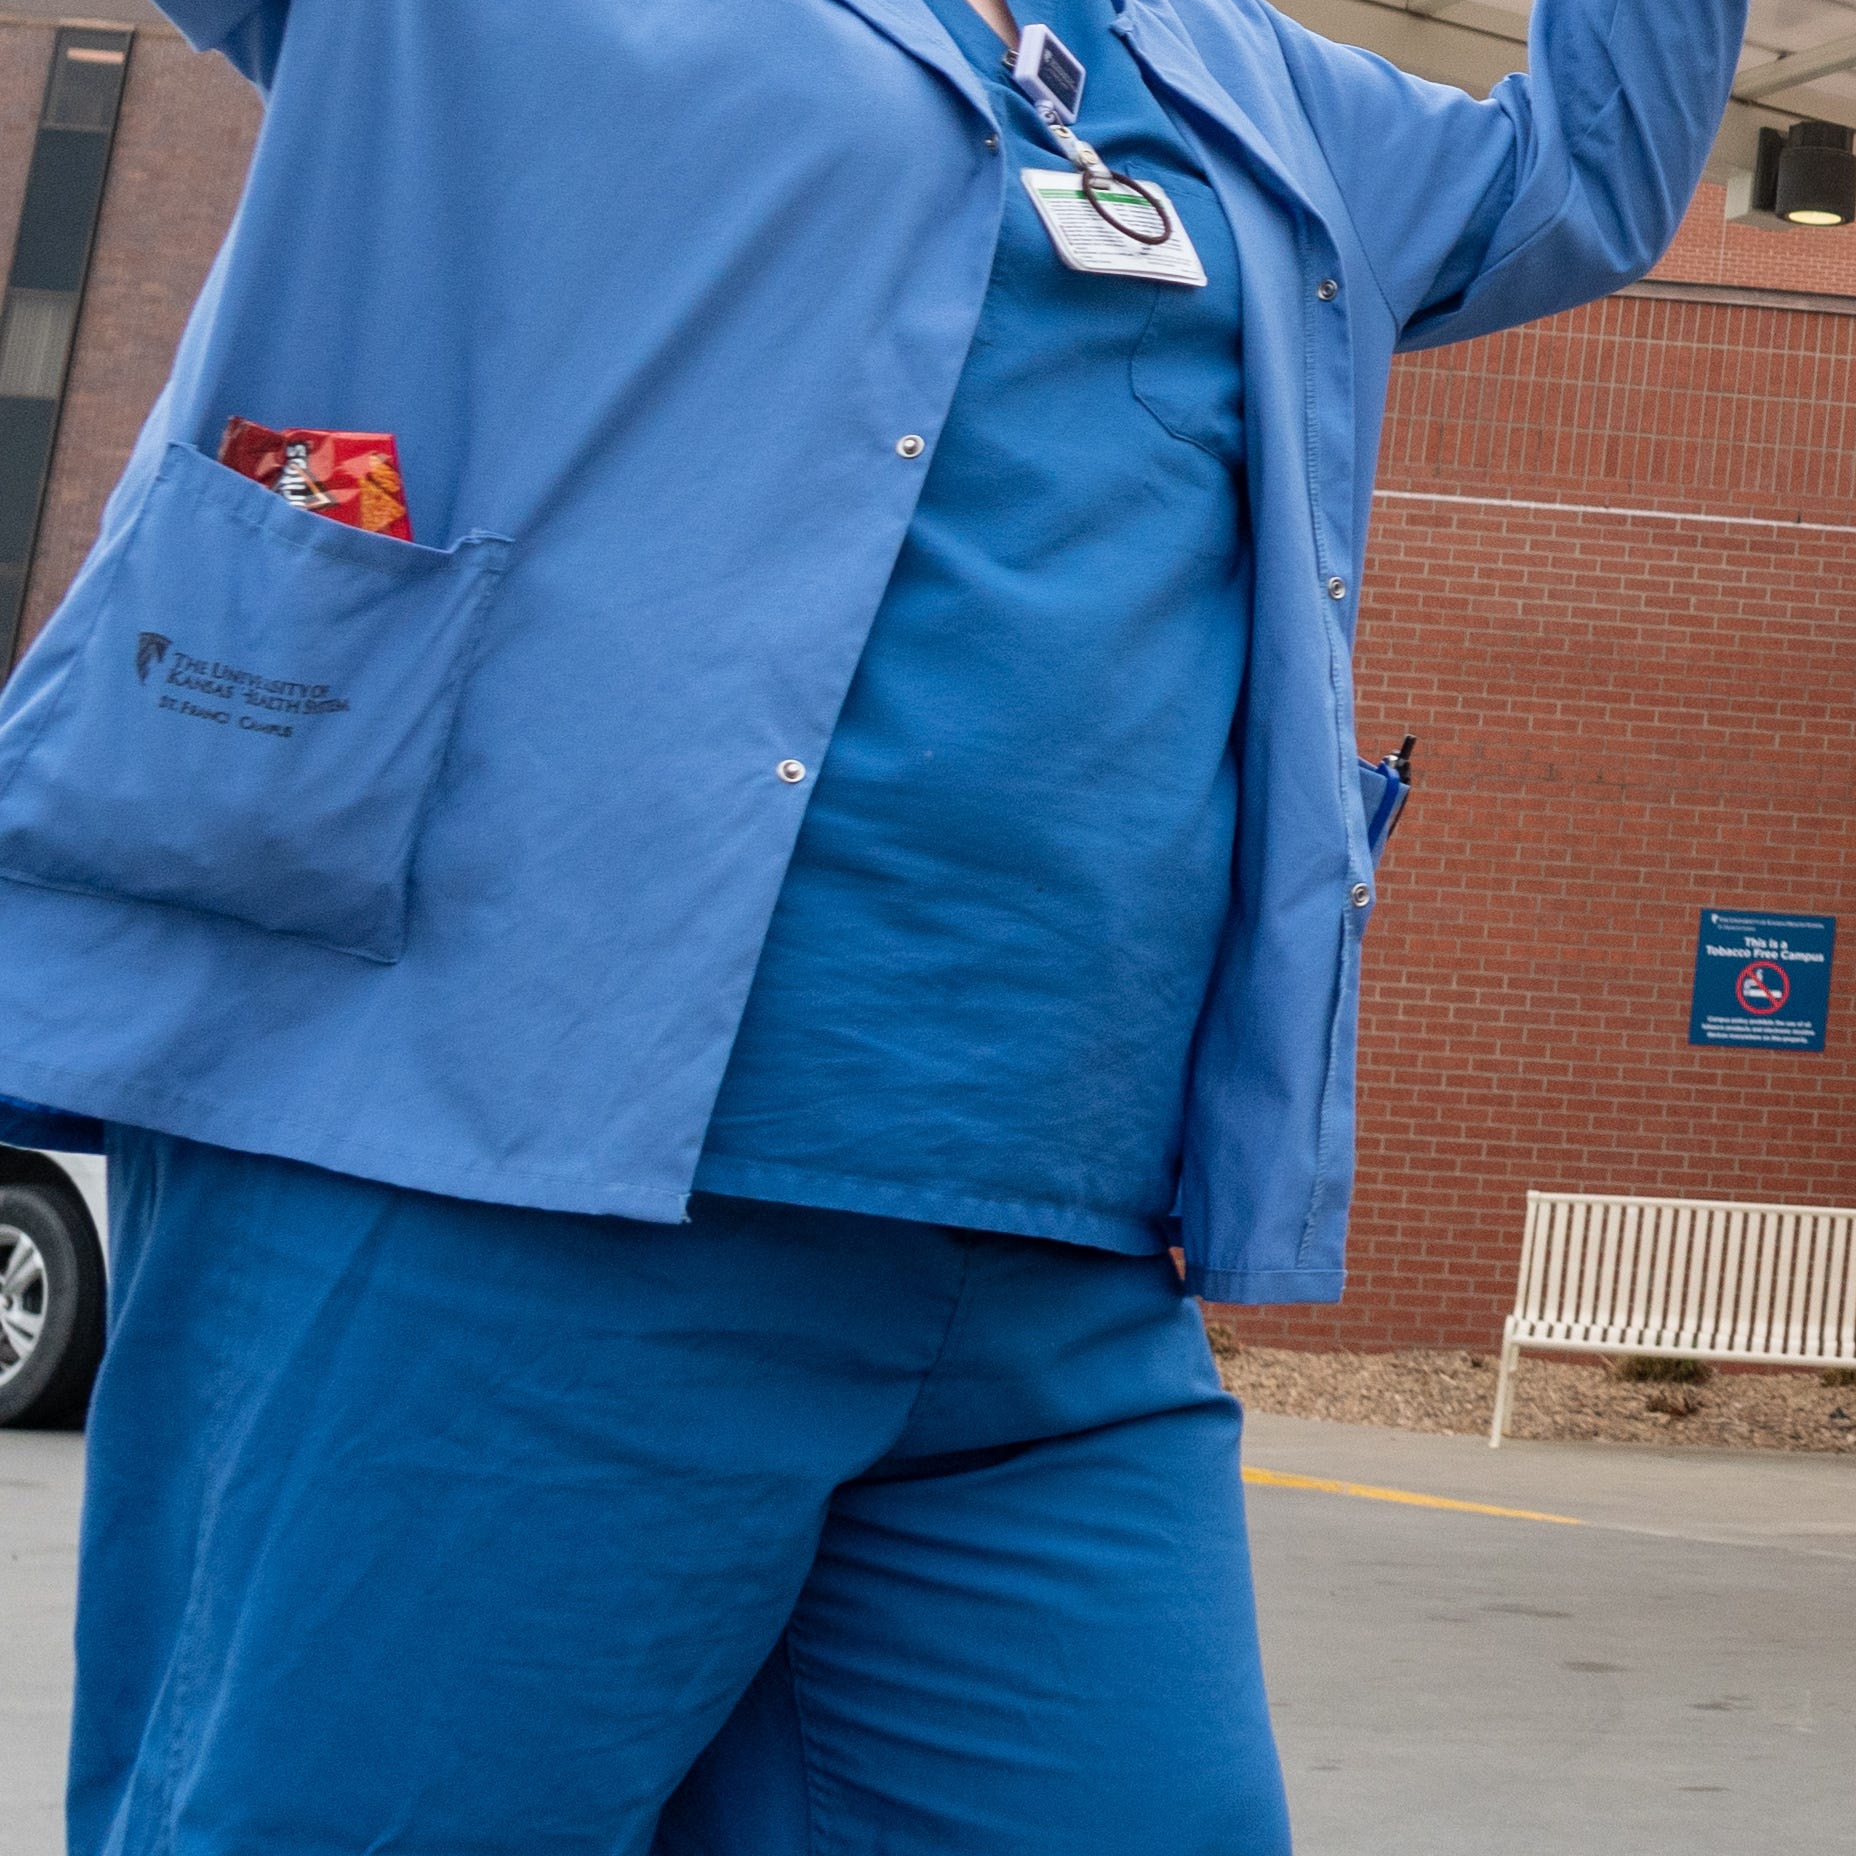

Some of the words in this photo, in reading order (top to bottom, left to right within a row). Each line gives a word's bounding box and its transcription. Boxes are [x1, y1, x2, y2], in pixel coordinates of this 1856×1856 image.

[1744, 936, 1767, 949] This
[1769, 938, 1778, 949] is
[1780, 940, 1788, 950] a
[1705, 944, 1751, 958] Tobacco
[1753, 948, 1778, 960] Free
[1780, 950, 1825, 963] Campus
